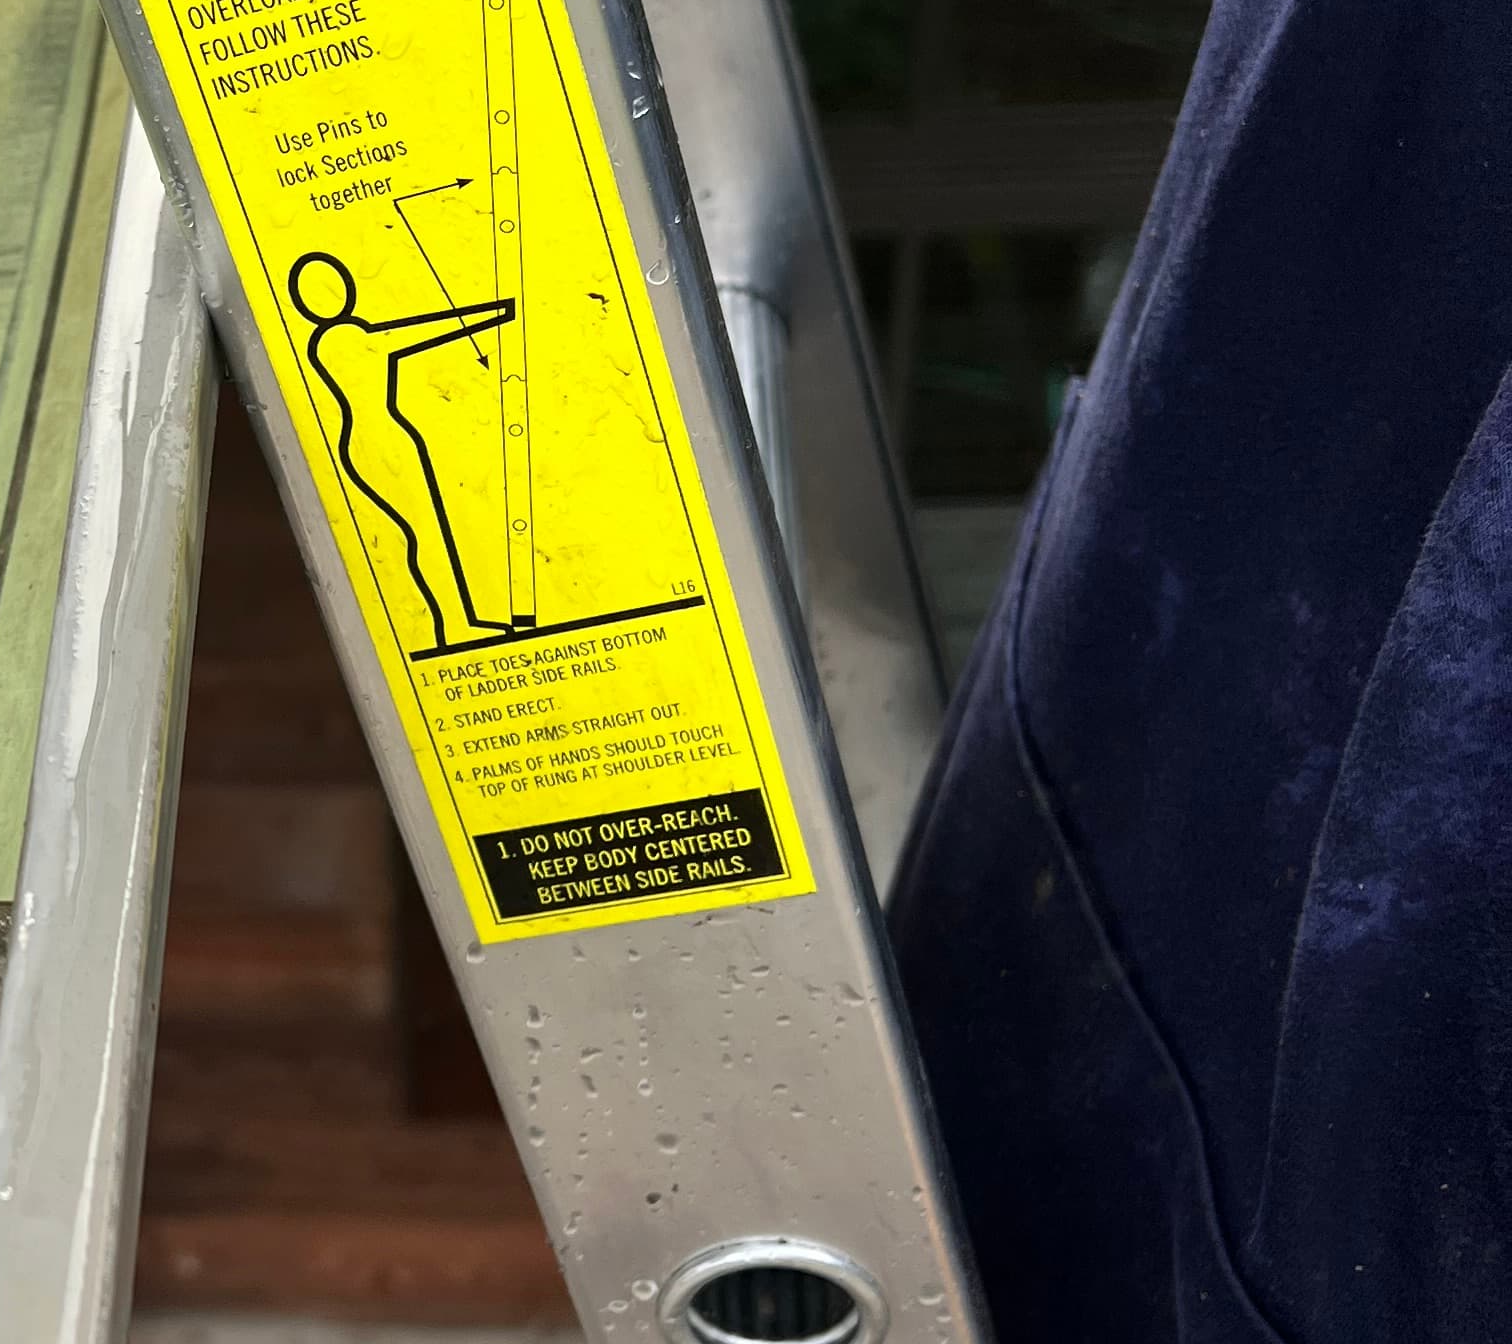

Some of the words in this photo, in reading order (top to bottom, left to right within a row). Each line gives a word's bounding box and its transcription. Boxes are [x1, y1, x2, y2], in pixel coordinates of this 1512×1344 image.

[198, 19, 287, 65] FOLLOW
[210, 34, 380, 100] INSTRUCTIONS.
[274, 131, 313, 154] Use
[316, 118, 362, 143] Pins
[365, 110, 387, 130] to
[276, 160, 318, 187] lock
[320, 140, 407, 175] Sections
[309, 176, 391, 211] together
[671, 579, 695, 595] L16
[437, 661, 487, 683] PLACE
[490, 653, 529, 673] TOES
[534, 639, 596, 665] AGAINST
[601, 626, 666, 651] BOTTOM
[444, 685, 462, 701] OF
[467, 673, 528, 697] LADDER
[531, 665, 565, 685] SIDE
[570, 656, 621, 677] RAILS.
[453, 707, 502, 728] STAND
[462, 732, 520, 754] EXTEND
[526, 723, 569, 743] ARMS
[571, 709, 644, 734] STRAIGHT
[471, 759, 522, 780] PALMS
[525, 755, 543, 771] OF
[548, 745, 600, 766] HANDS
[603, 734, 666, 757] SHOULD
[671, 724, 723, 744] TOUCH
[478, 781, 506, 798] TOP
[511, 777, 529, 793] OF
[533, 769, 578, 789] RUNG
[581, 765, 598, 781] AT
[602, 750, 686, 777] SHOULDER
[519, 834, 549, 855] DO
[552, 825, 592, 850] NOT
[598, 803, 738, 842] OVER-REACH.
[527, 855, 578, 880] KEEP
[583, 844, 637, 871] BODY
[644, 827, 751, 861] CENTERED
[536, 872, 631, 904] BETWEEN
[634, 864, 683, 889] SIDE
[685, 854, 751, 881] RAILS.
